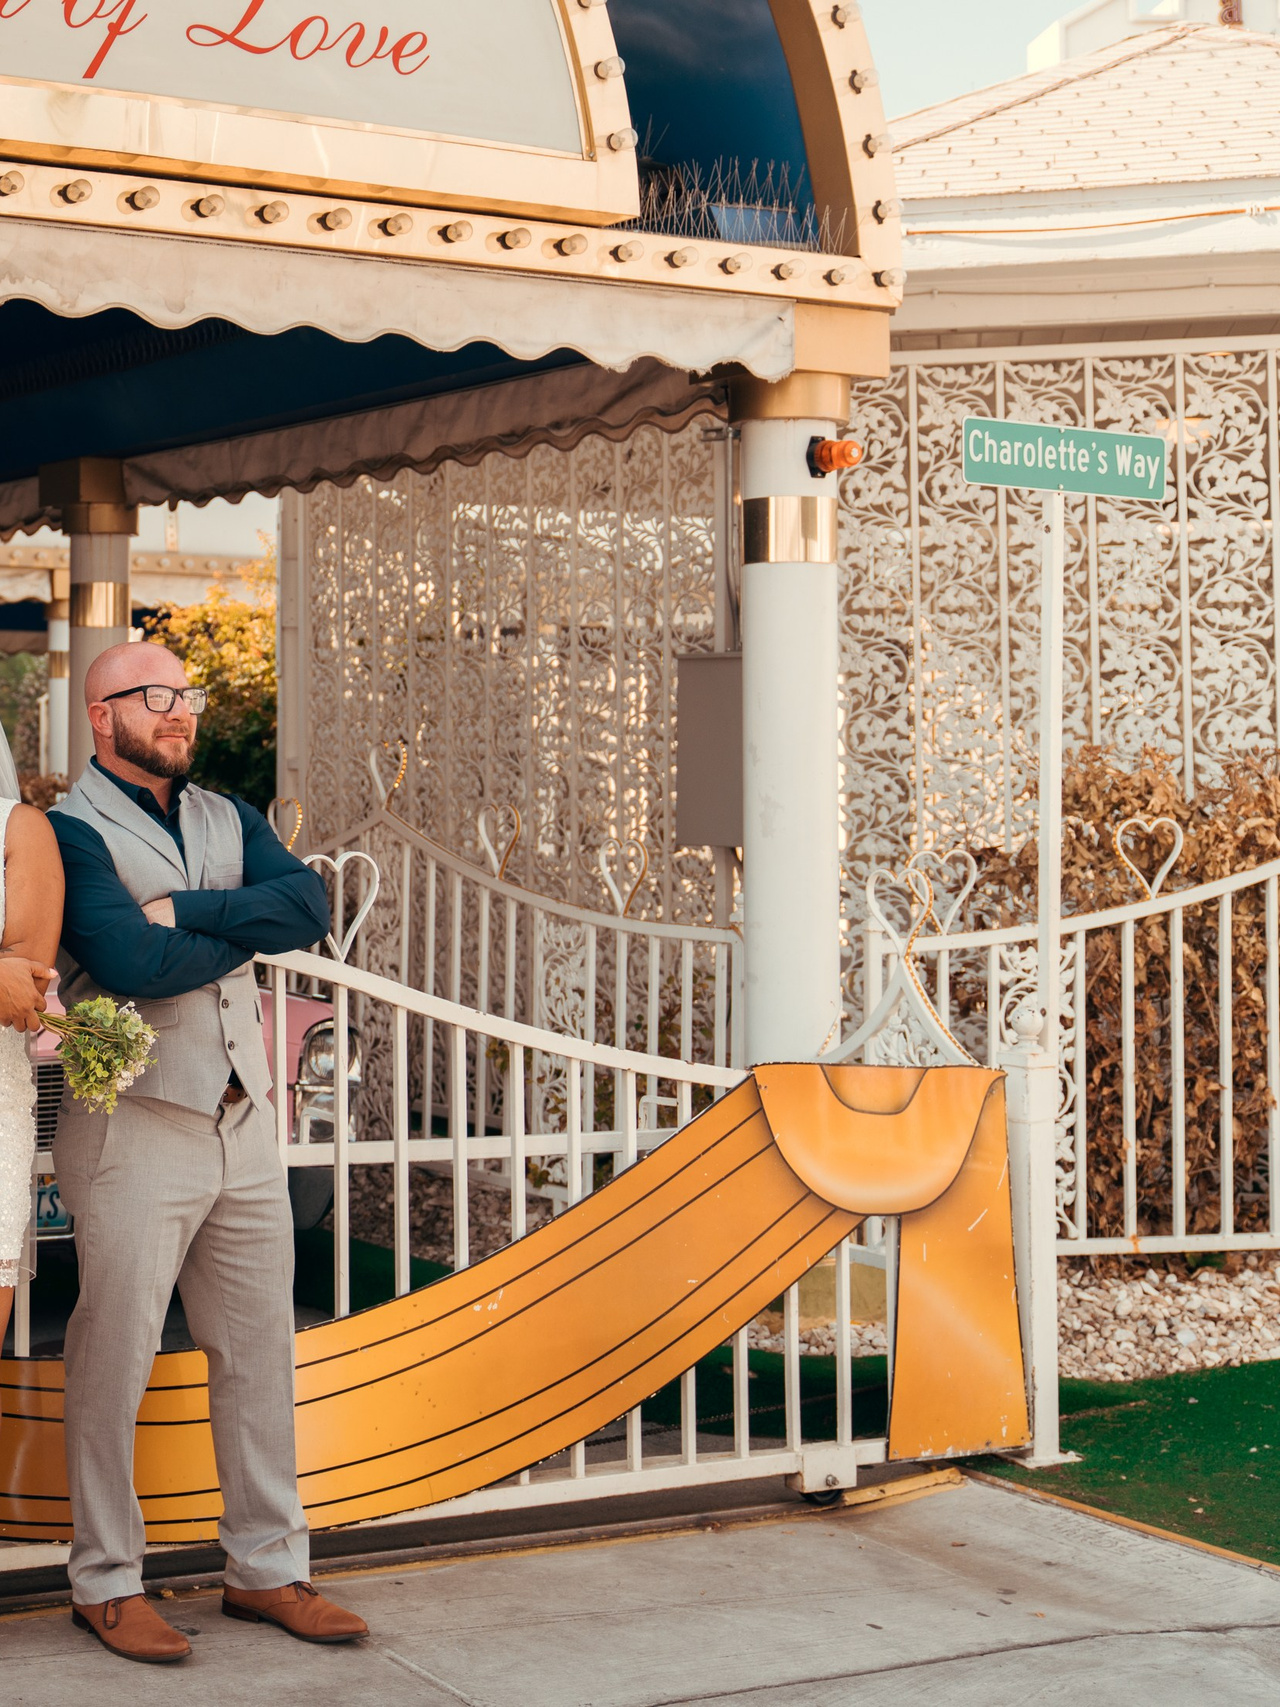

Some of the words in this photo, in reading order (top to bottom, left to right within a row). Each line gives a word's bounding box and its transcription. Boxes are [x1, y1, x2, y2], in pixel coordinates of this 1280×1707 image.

[185, 0, 431, 76] Love
[968, 428, 1108, 475] Charolette's
[1115, 444, 1161, 490] Way
